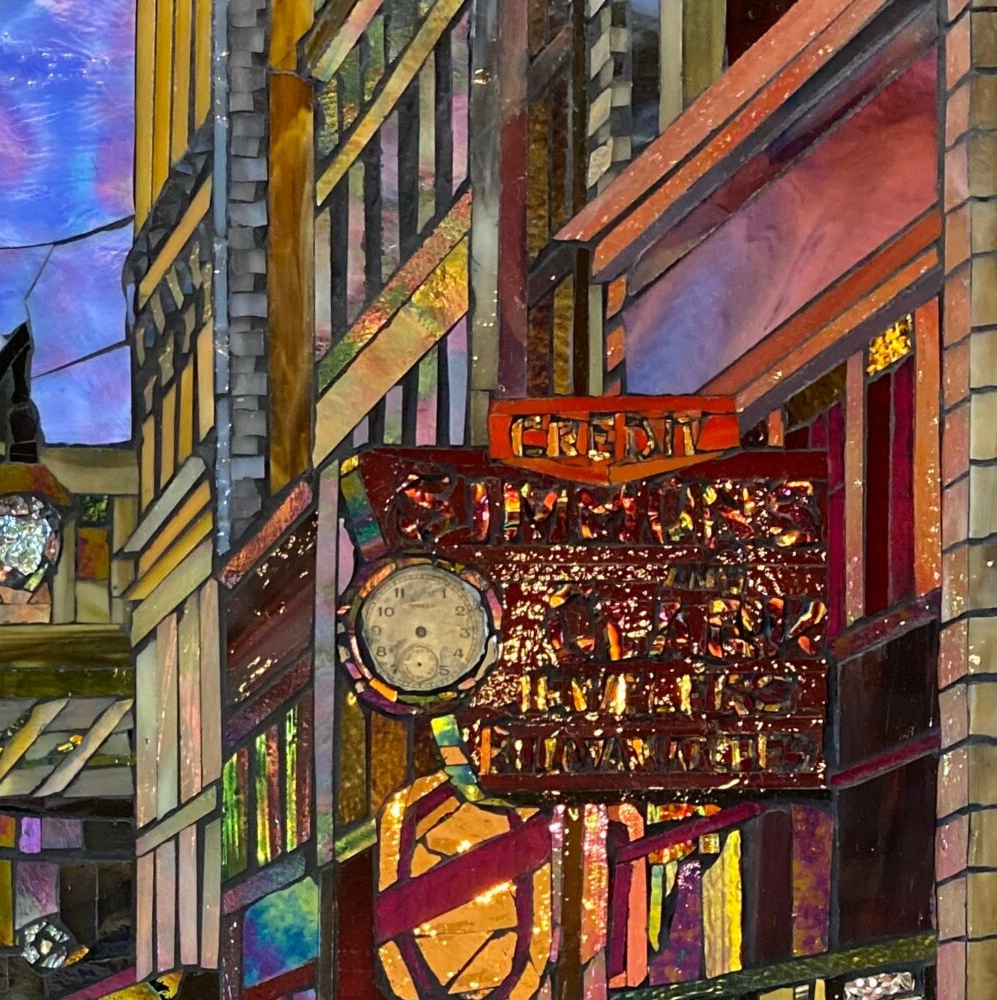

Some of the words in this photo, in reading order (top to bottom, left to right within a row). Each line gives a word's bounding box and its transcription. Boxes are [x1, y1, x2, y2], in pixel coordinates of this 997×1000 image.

[511, 412, 699, 461] CREDIT
[394, 473, 816, 545] SIMMONS
[378, 607, 395, 618] 10
[455, 606, 466, 616] 2
[371, 626, 382, 637] 9
[459, 628, 470, 639] 3
[376, 647, 387, 658] 8
[454, 648, 464, 659] 4
[439, 666, 450, 676] 5
